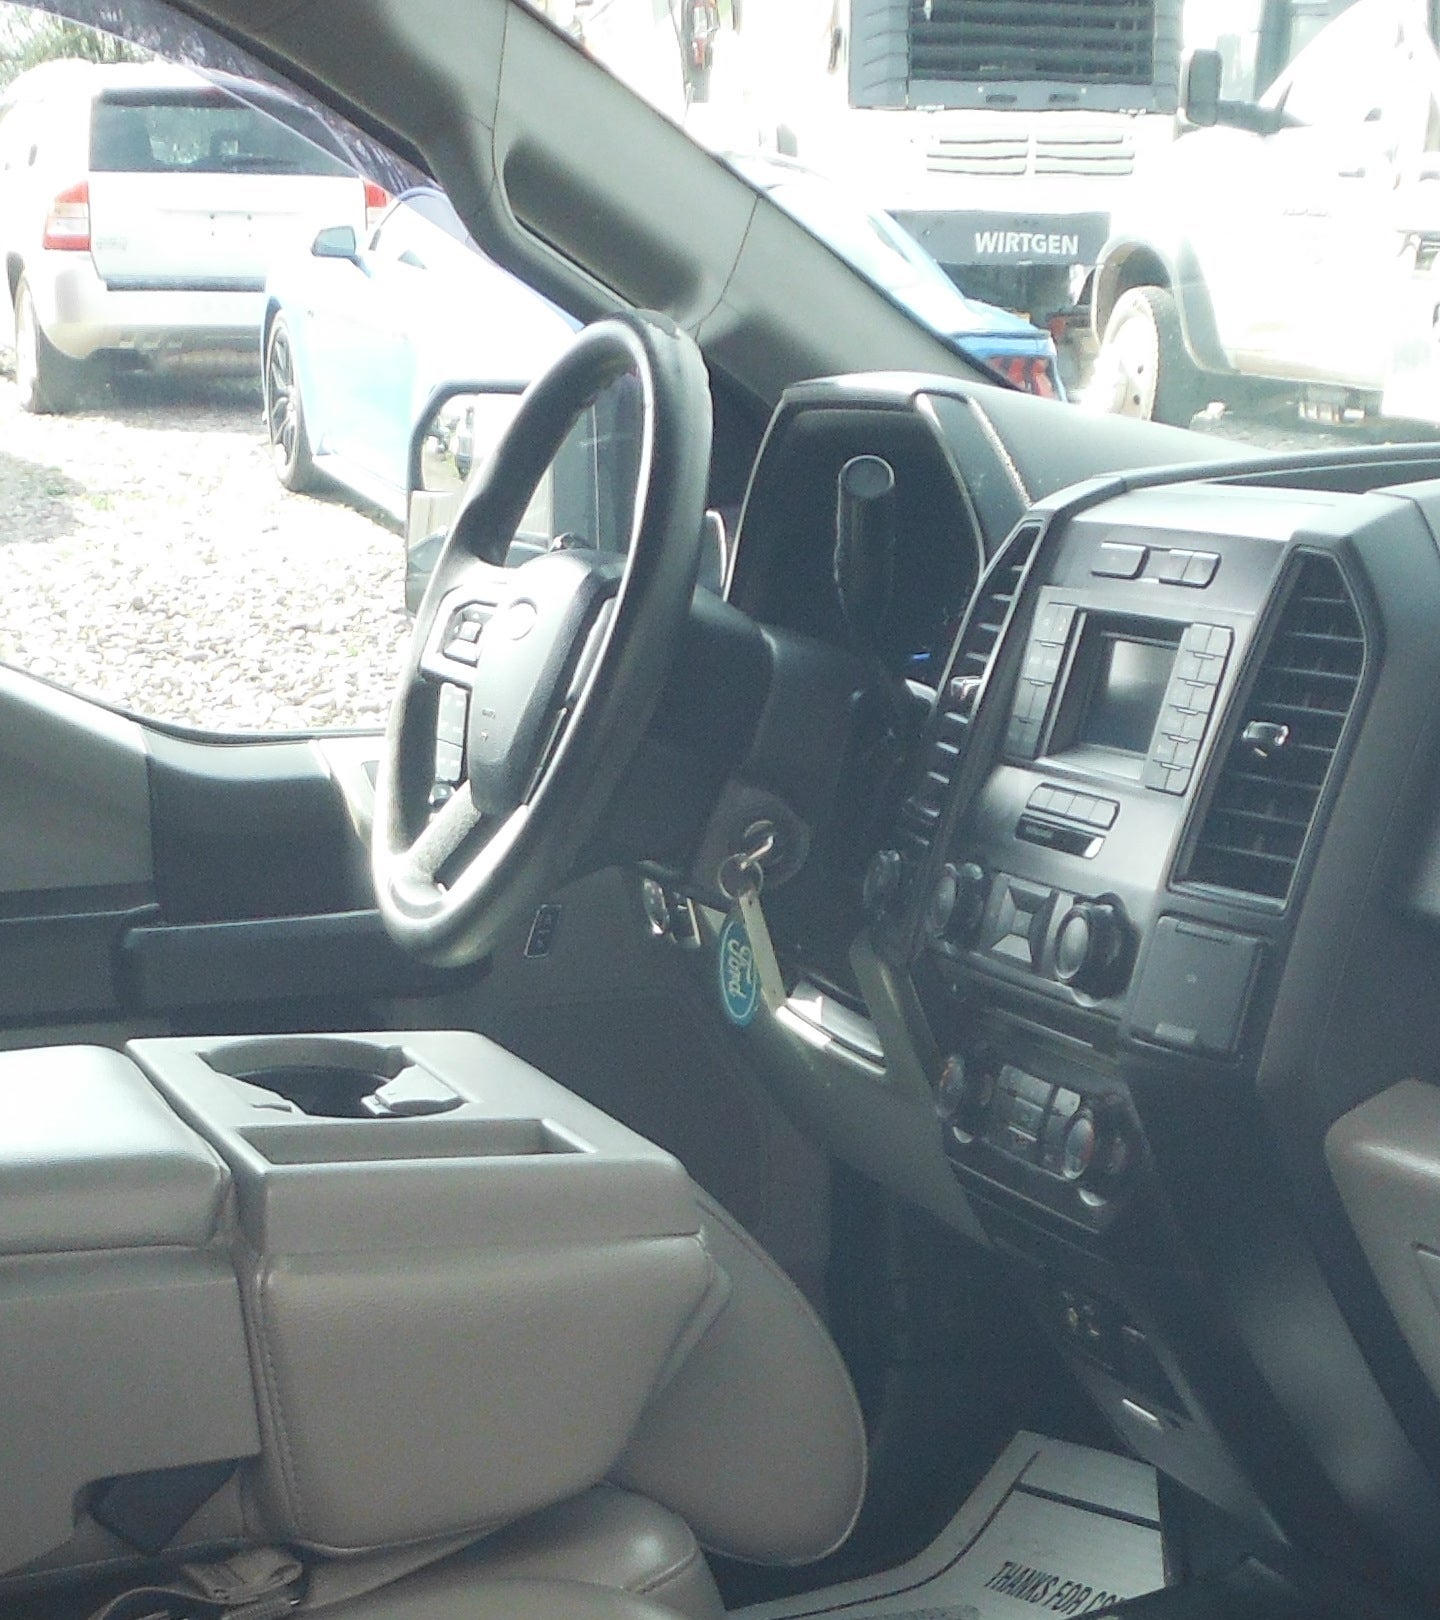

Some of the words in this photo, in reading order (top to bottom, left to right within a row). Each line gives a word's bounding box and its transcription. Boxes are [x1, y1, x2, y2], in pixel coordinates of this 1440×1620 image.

[974, 231, 1079, 256] WIRTGEN
[727, 939, 752, 999] Ford
[983, 1561, 1060, 1604] THANKS
[1042, 1580, 1093, 1616] FOR
